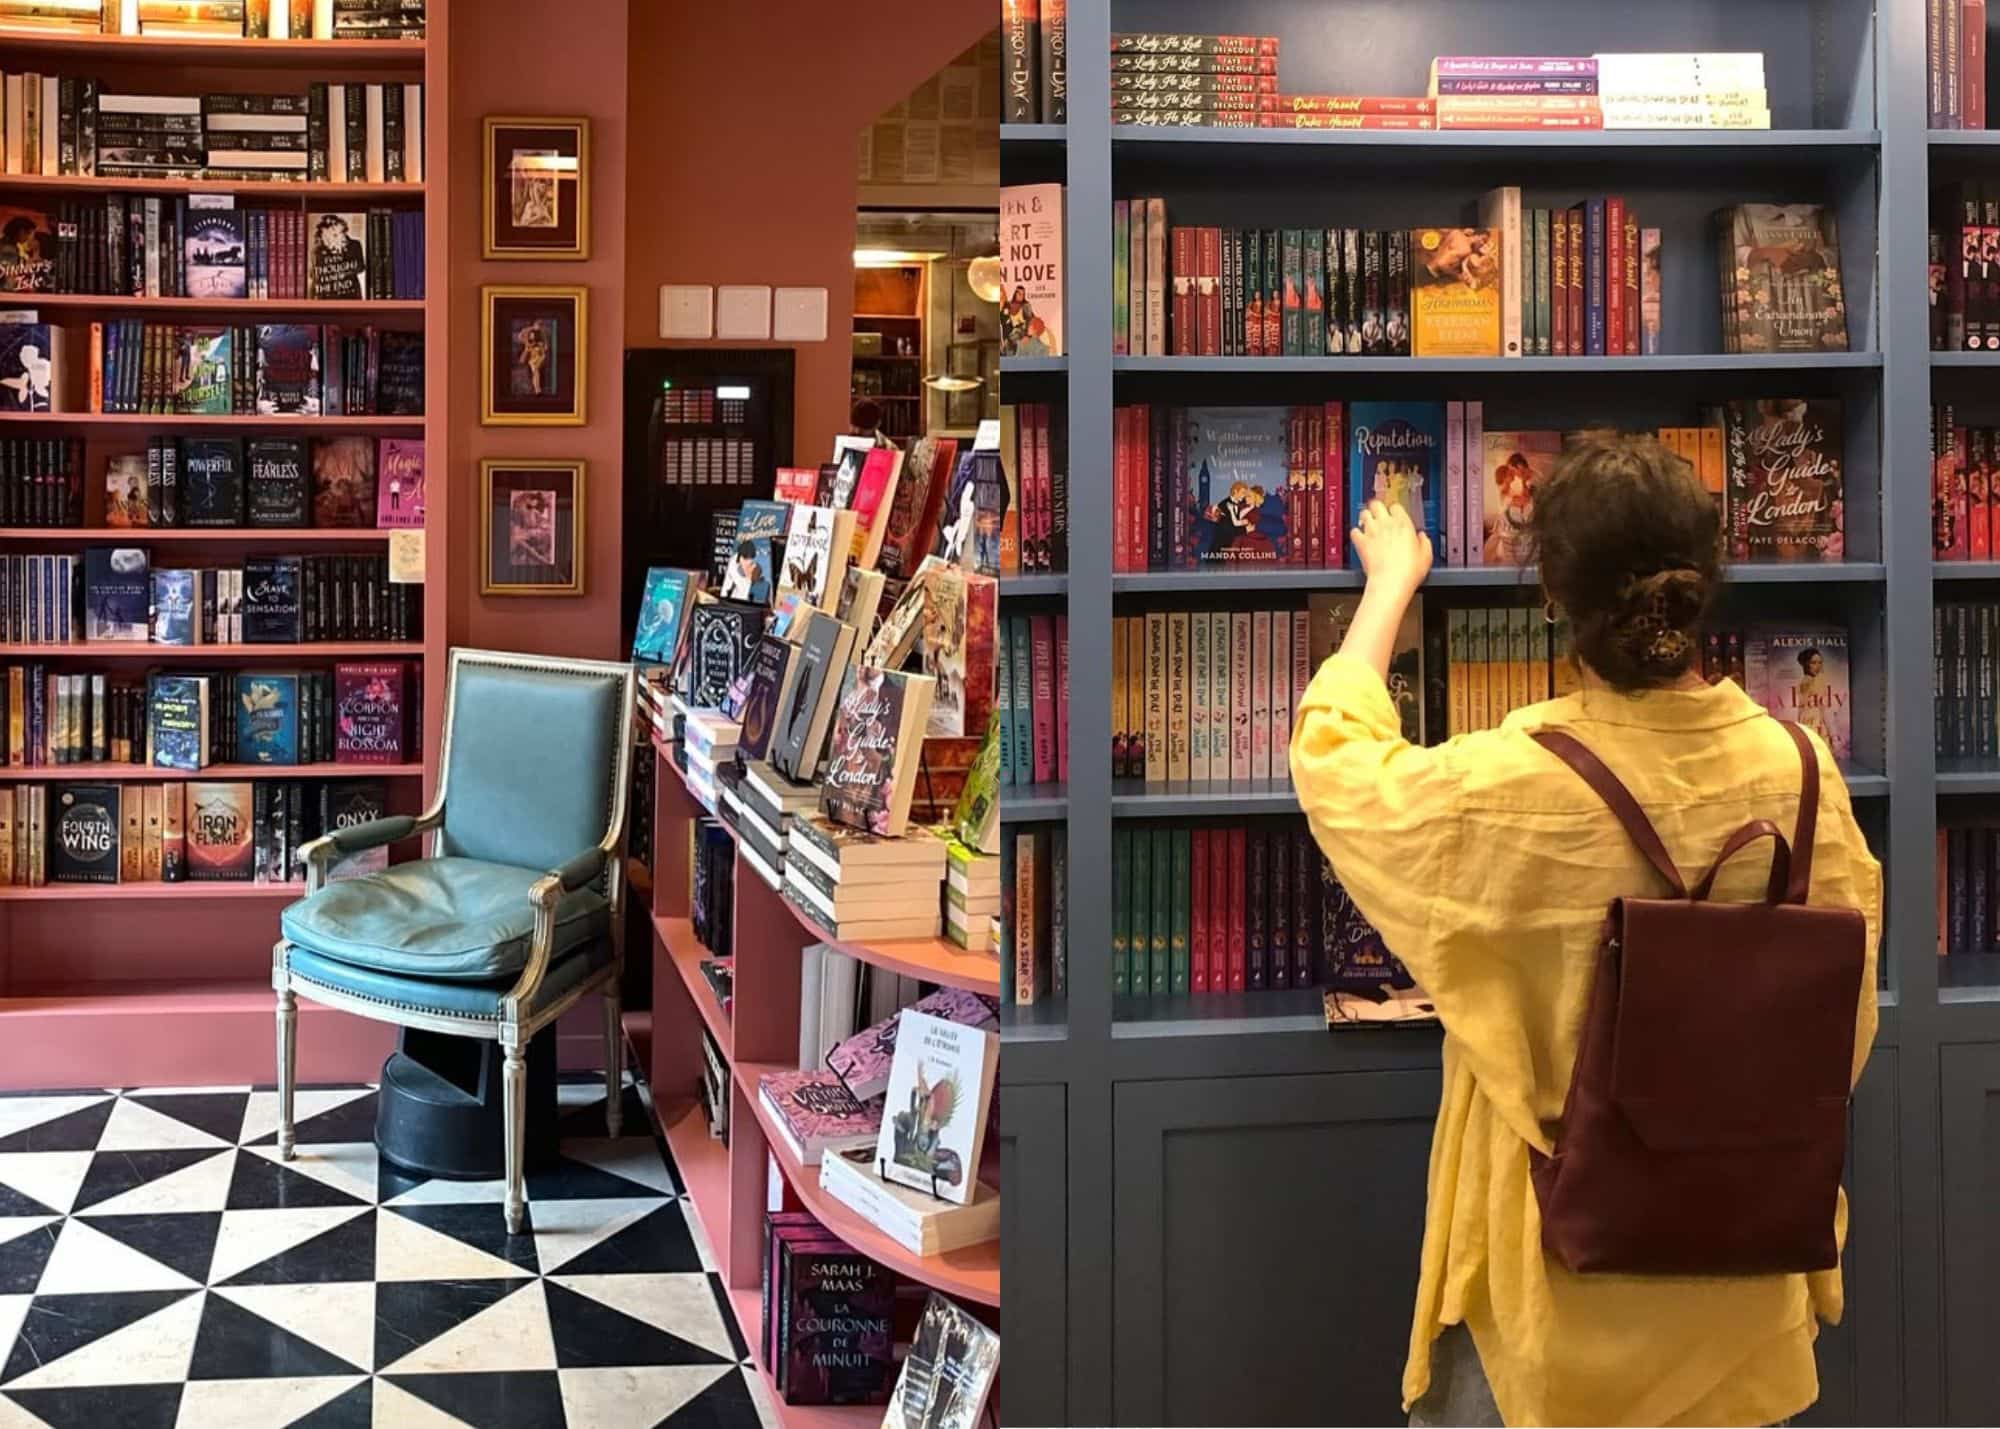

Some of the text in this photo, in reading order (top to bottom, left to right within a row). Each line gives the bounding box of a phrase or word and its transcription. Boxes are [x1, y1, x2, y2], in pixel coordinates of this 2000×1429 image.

[1010, 243, 1042, 262] NOT
[1014, 264, 1056, 283] LOVE
[1224, 287, 1232, 309] CLASS
[1235, 287, 1243, 309] CLASS
[1356, 426, 1434, 455] Reputation
[1757, 420, 1824, 457] Lady's
[187, 458, 234, 472] POWERFUL
[253, 460, 299, 479] FEARLESS
[1761, 453, 1831, 496] Guide
[1747, 491, 1827, 526] London
[1200, 552, 1277, 560] MANDA COLLINS
[1773, 637, 1847, 647] ALEXIS HALL
[1791, 684, 1843, 708] Lady
[339, 738, 398, 751] BLOSSOM
[825, 755, 882, 788] London
[62, 820, 111, 834] FOURTH
[198, 815, 237, 829] IRON
[62, 833, 112, 851] WING
[195, 832, 240, 846] FLAME
[1021, 912, 1029, 937] ALSO
[1021, 951, 1029, 976] STAR
[811, 1263, 876, 1278] SARAH J.
[821, 1279, 863, 1292] MAAS
[795, 1317, 888, 1333] COURONNE
[813, 1353, 872, 1367] MINUIT
